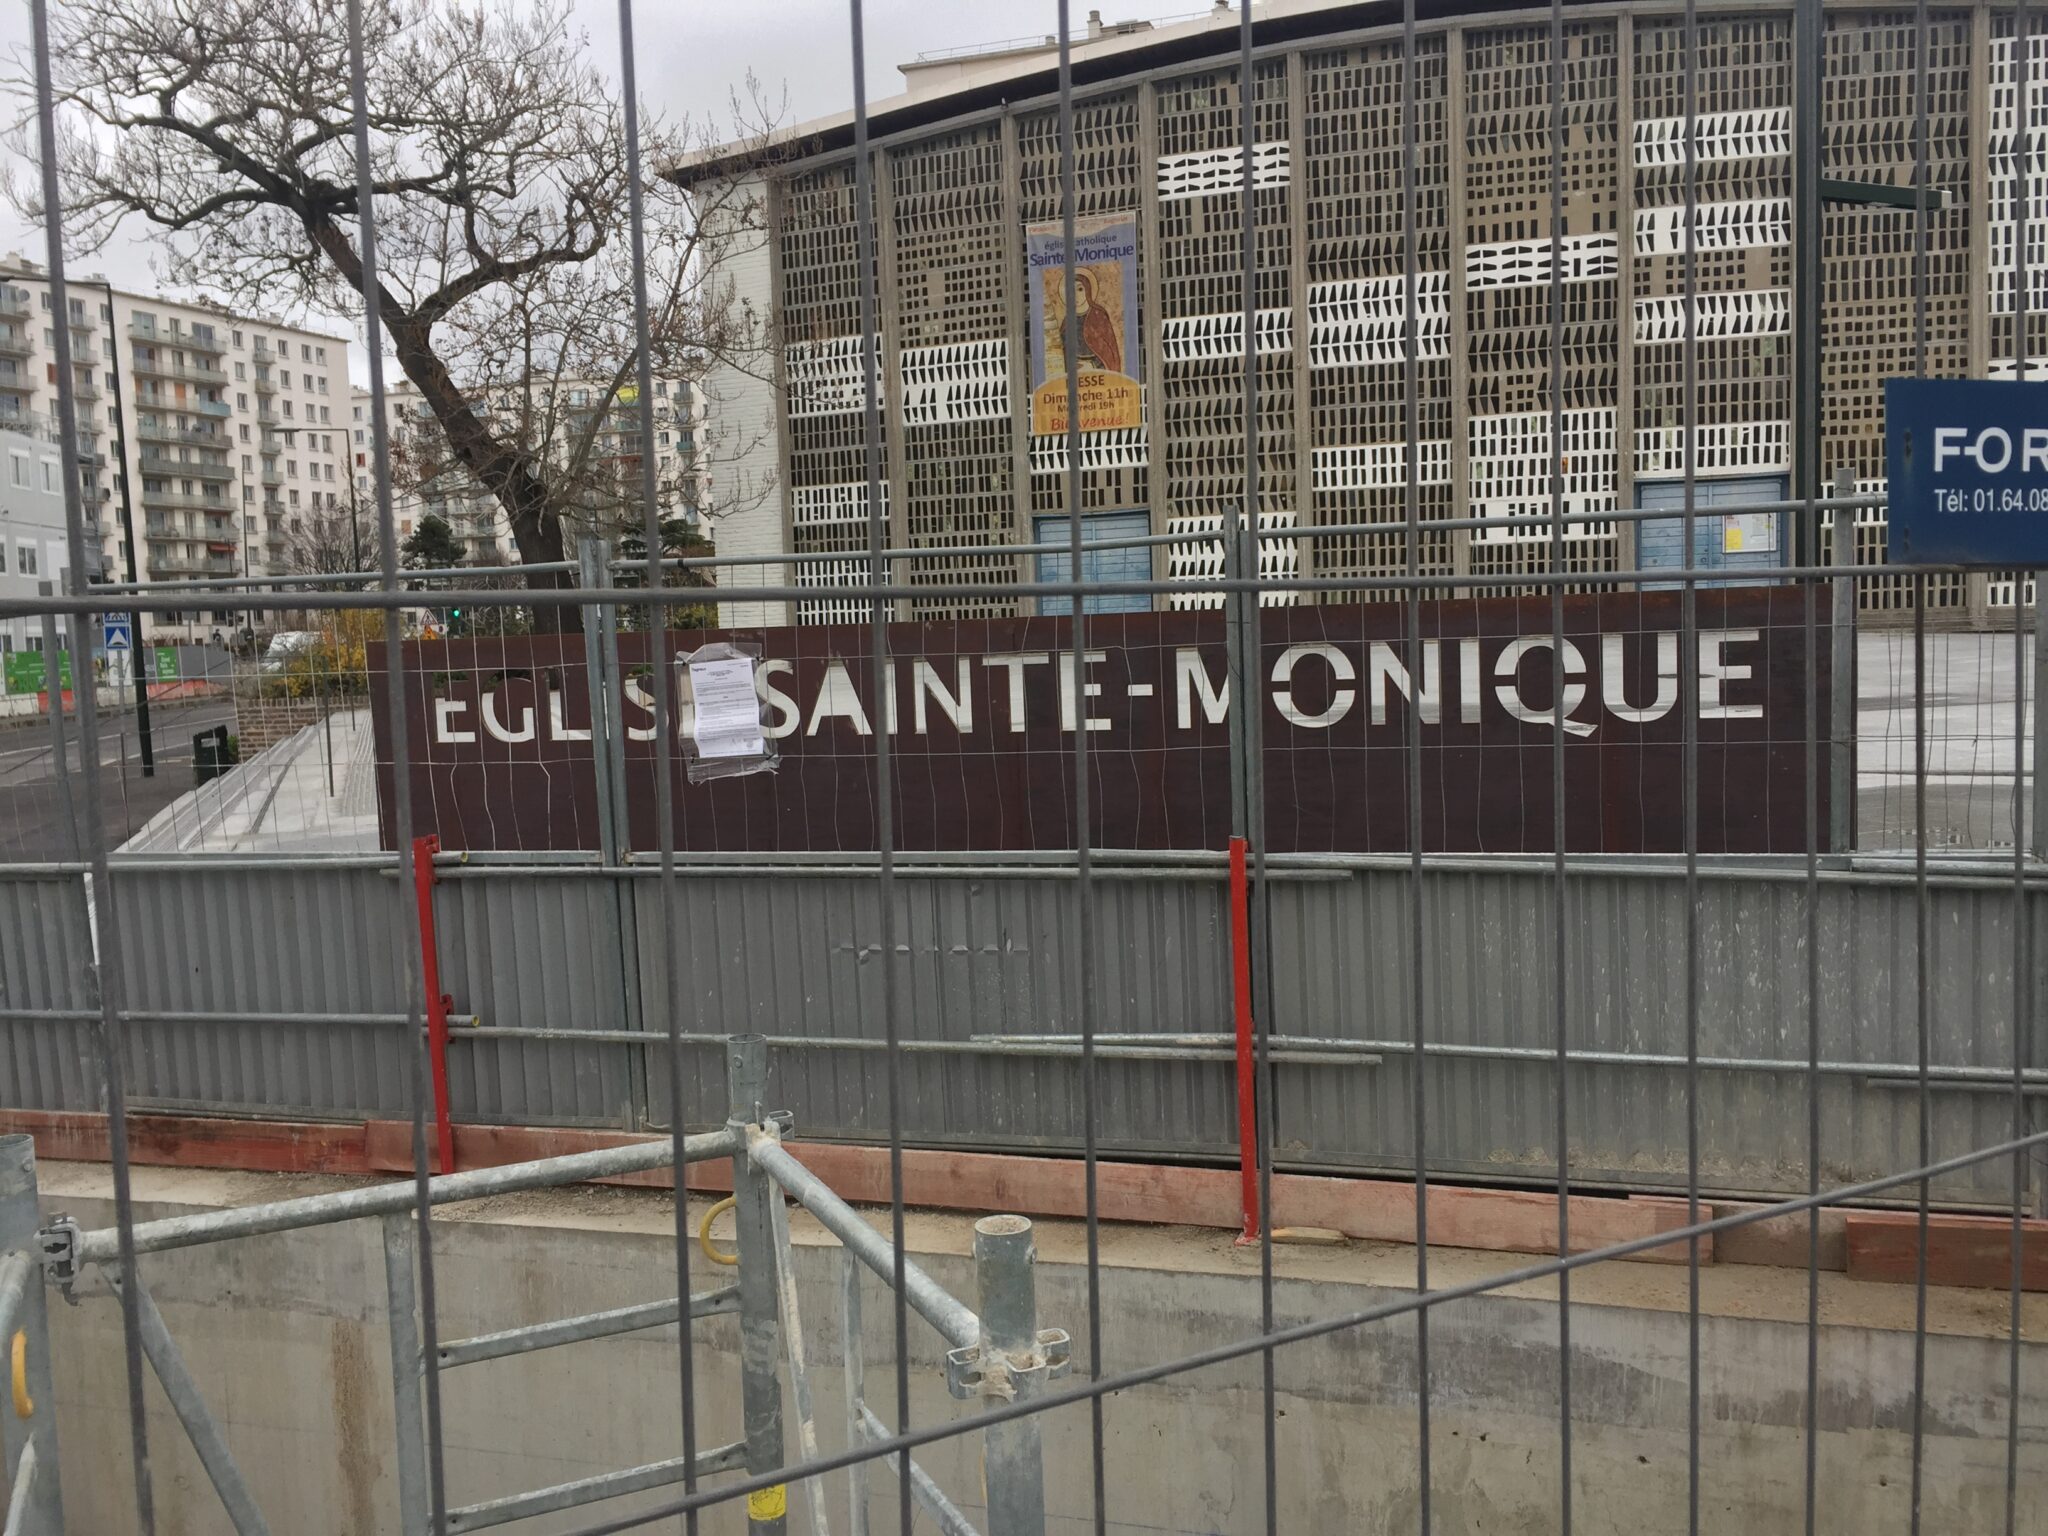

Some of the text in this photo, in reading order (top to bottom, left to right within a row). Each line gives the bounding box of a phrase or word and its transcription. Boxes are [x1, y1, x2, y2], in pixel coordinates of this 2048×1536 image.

[1044, 234, 1117, 252] églis atholique
[1074, 244, 1134, 262] Monique
[1066, 374, 1105, 389] ESSE
[1043, 387, 1129, 405] Dimche 11h
[1098, 401, 1115, 410] 19h
[1934, 488, 1969, 513] Tél:
[432, 658, 734, 744] EGLS
